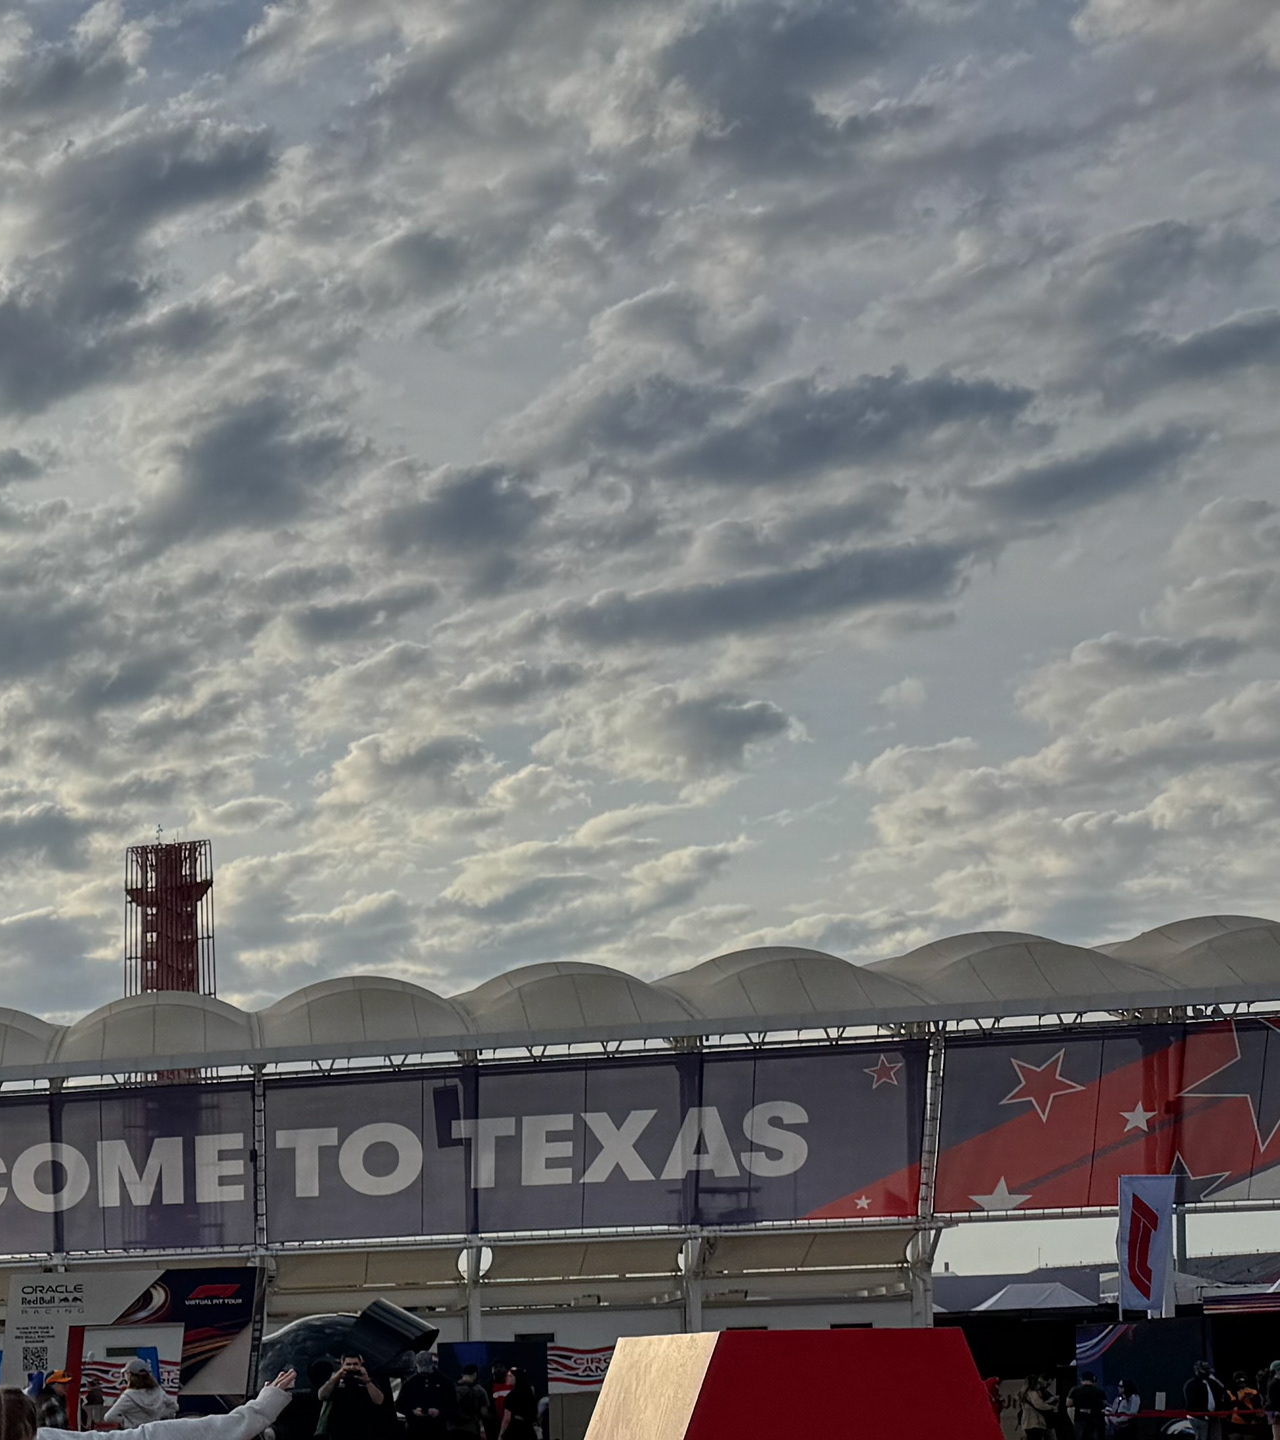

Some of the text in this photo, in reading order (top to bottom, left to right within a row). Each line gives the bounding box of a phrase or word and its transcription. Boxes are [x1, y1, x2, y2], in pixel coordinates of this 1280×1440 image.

[275, 1122, 423, 1198] TO
[451, 1100, 809, 1188] TEXAS
[21, 1284, 83, 1294] ORACLE
